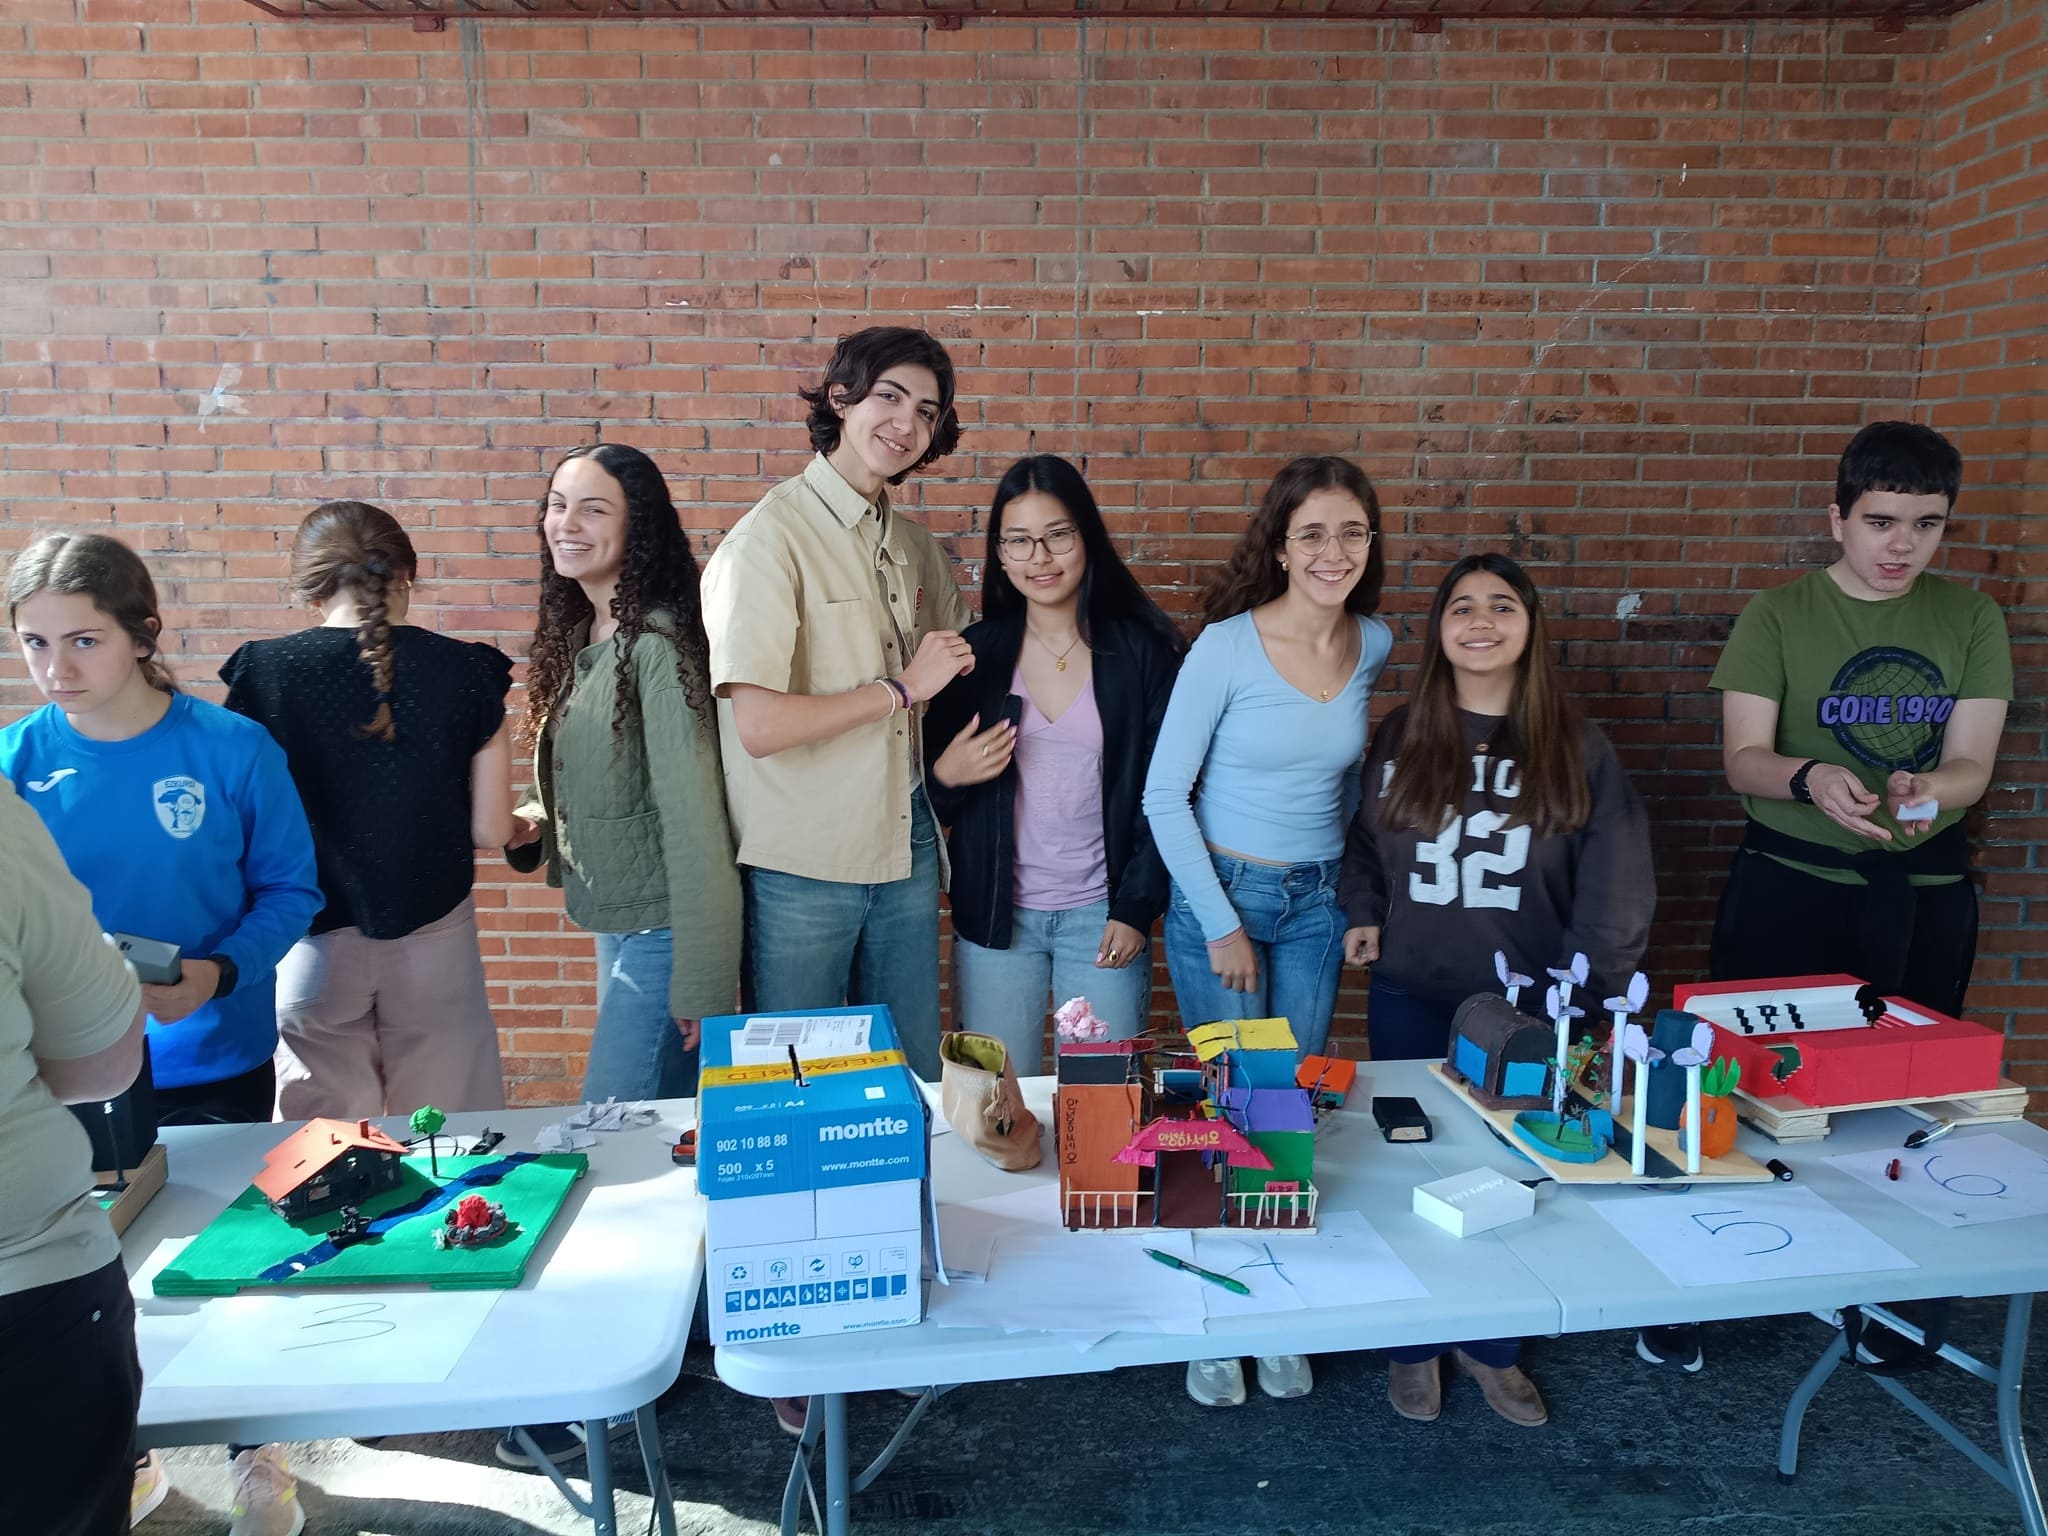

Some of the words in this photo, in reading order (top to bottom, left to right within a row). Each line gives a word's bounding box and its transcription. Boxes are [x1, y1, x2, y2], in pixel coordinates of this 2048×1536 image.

[1821, 695, 1891, 725] CORE
[1896, 695, 1954, 724] 1990
[1409, 805, 1532, 911] 32
[784, 1100, 806, 1108] A4
[819, 1116, 910, 1142] montte
[716, 1139, 738, 1153] 902
[740, 1137, 754, 1150] 10
[757, 1135, 771, 1148] 88
[774, 1134, 788, 1147] 88
[718, 1162, 742, 1176] 500
[766, 1159, 774, 1171] 5
[821, 1156, 910, 1171] www.montte.com
[1923, 1155, 2007, 1197] 6
[1690, 1210, 1793, 1256] 5
[280, 1302, 397, 1352] 3
[726, 1322, 801, 1342] montte
[843, 1317, 908, 1330] www.montte.com
